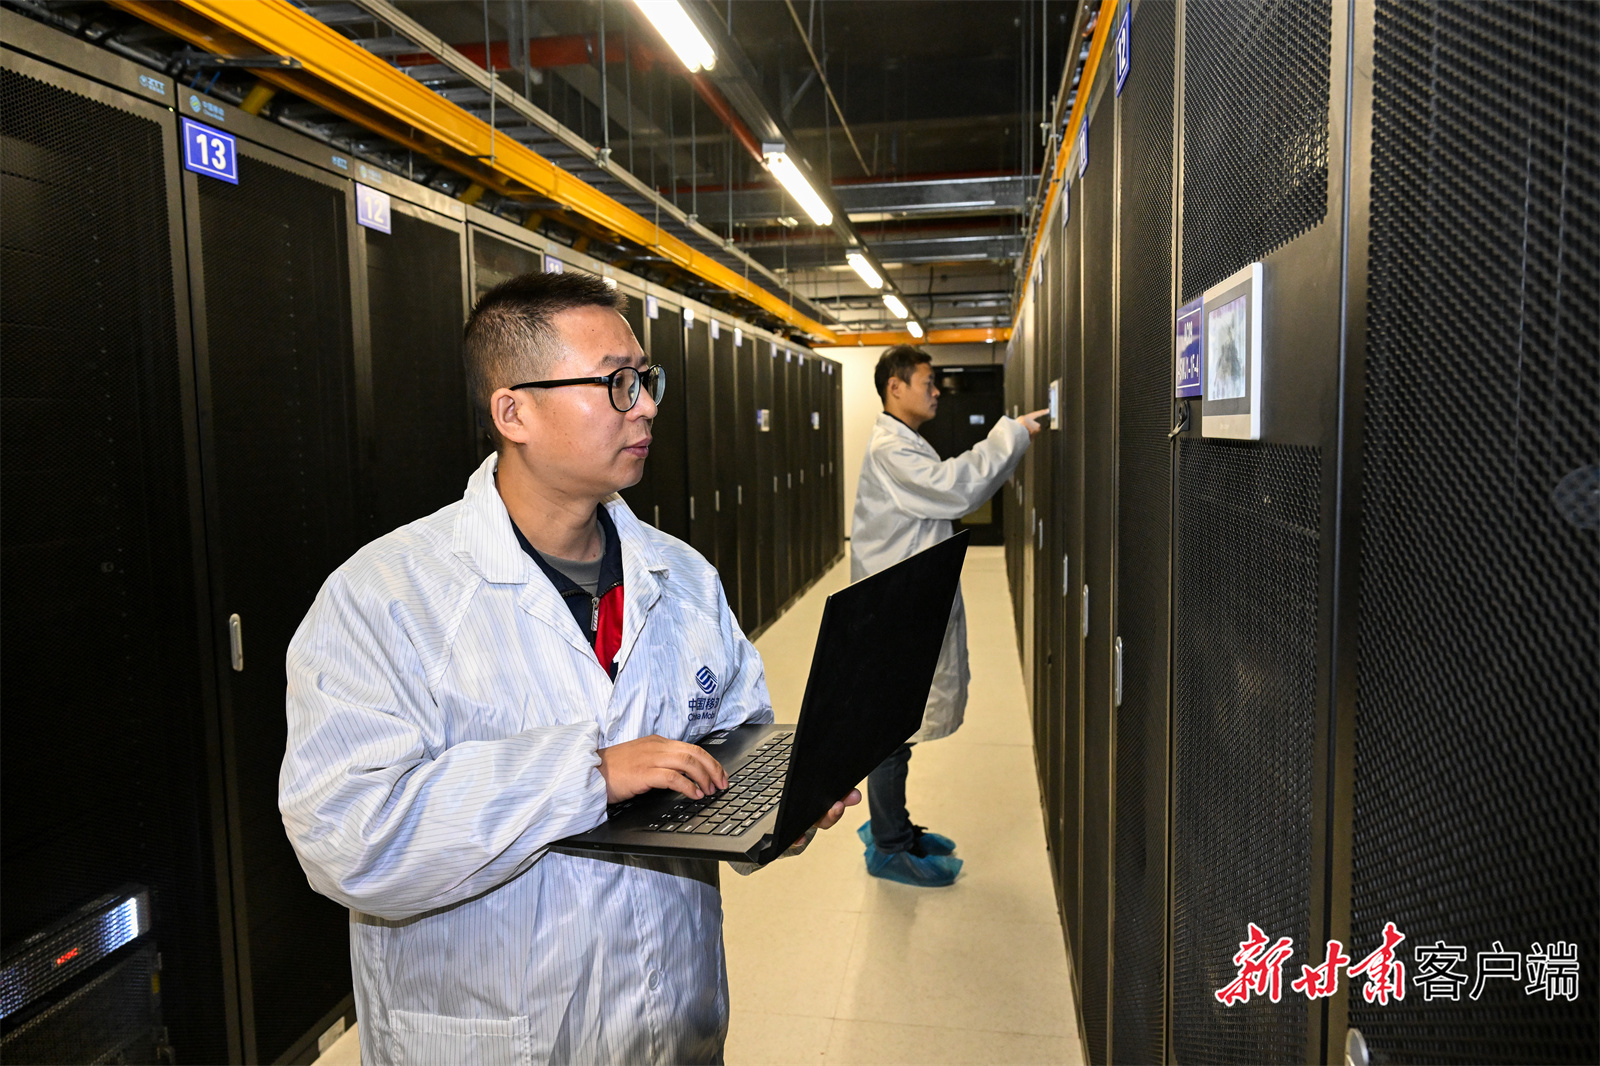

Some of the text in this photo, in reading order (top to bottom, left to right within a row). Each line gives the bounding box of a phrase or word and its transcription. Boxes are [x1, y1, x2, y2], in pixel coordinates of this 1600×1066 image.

[1118, 27, 1126, 76] 12
[196, 133, 226, 171] 13
[364, 196, 384, 223] 12
